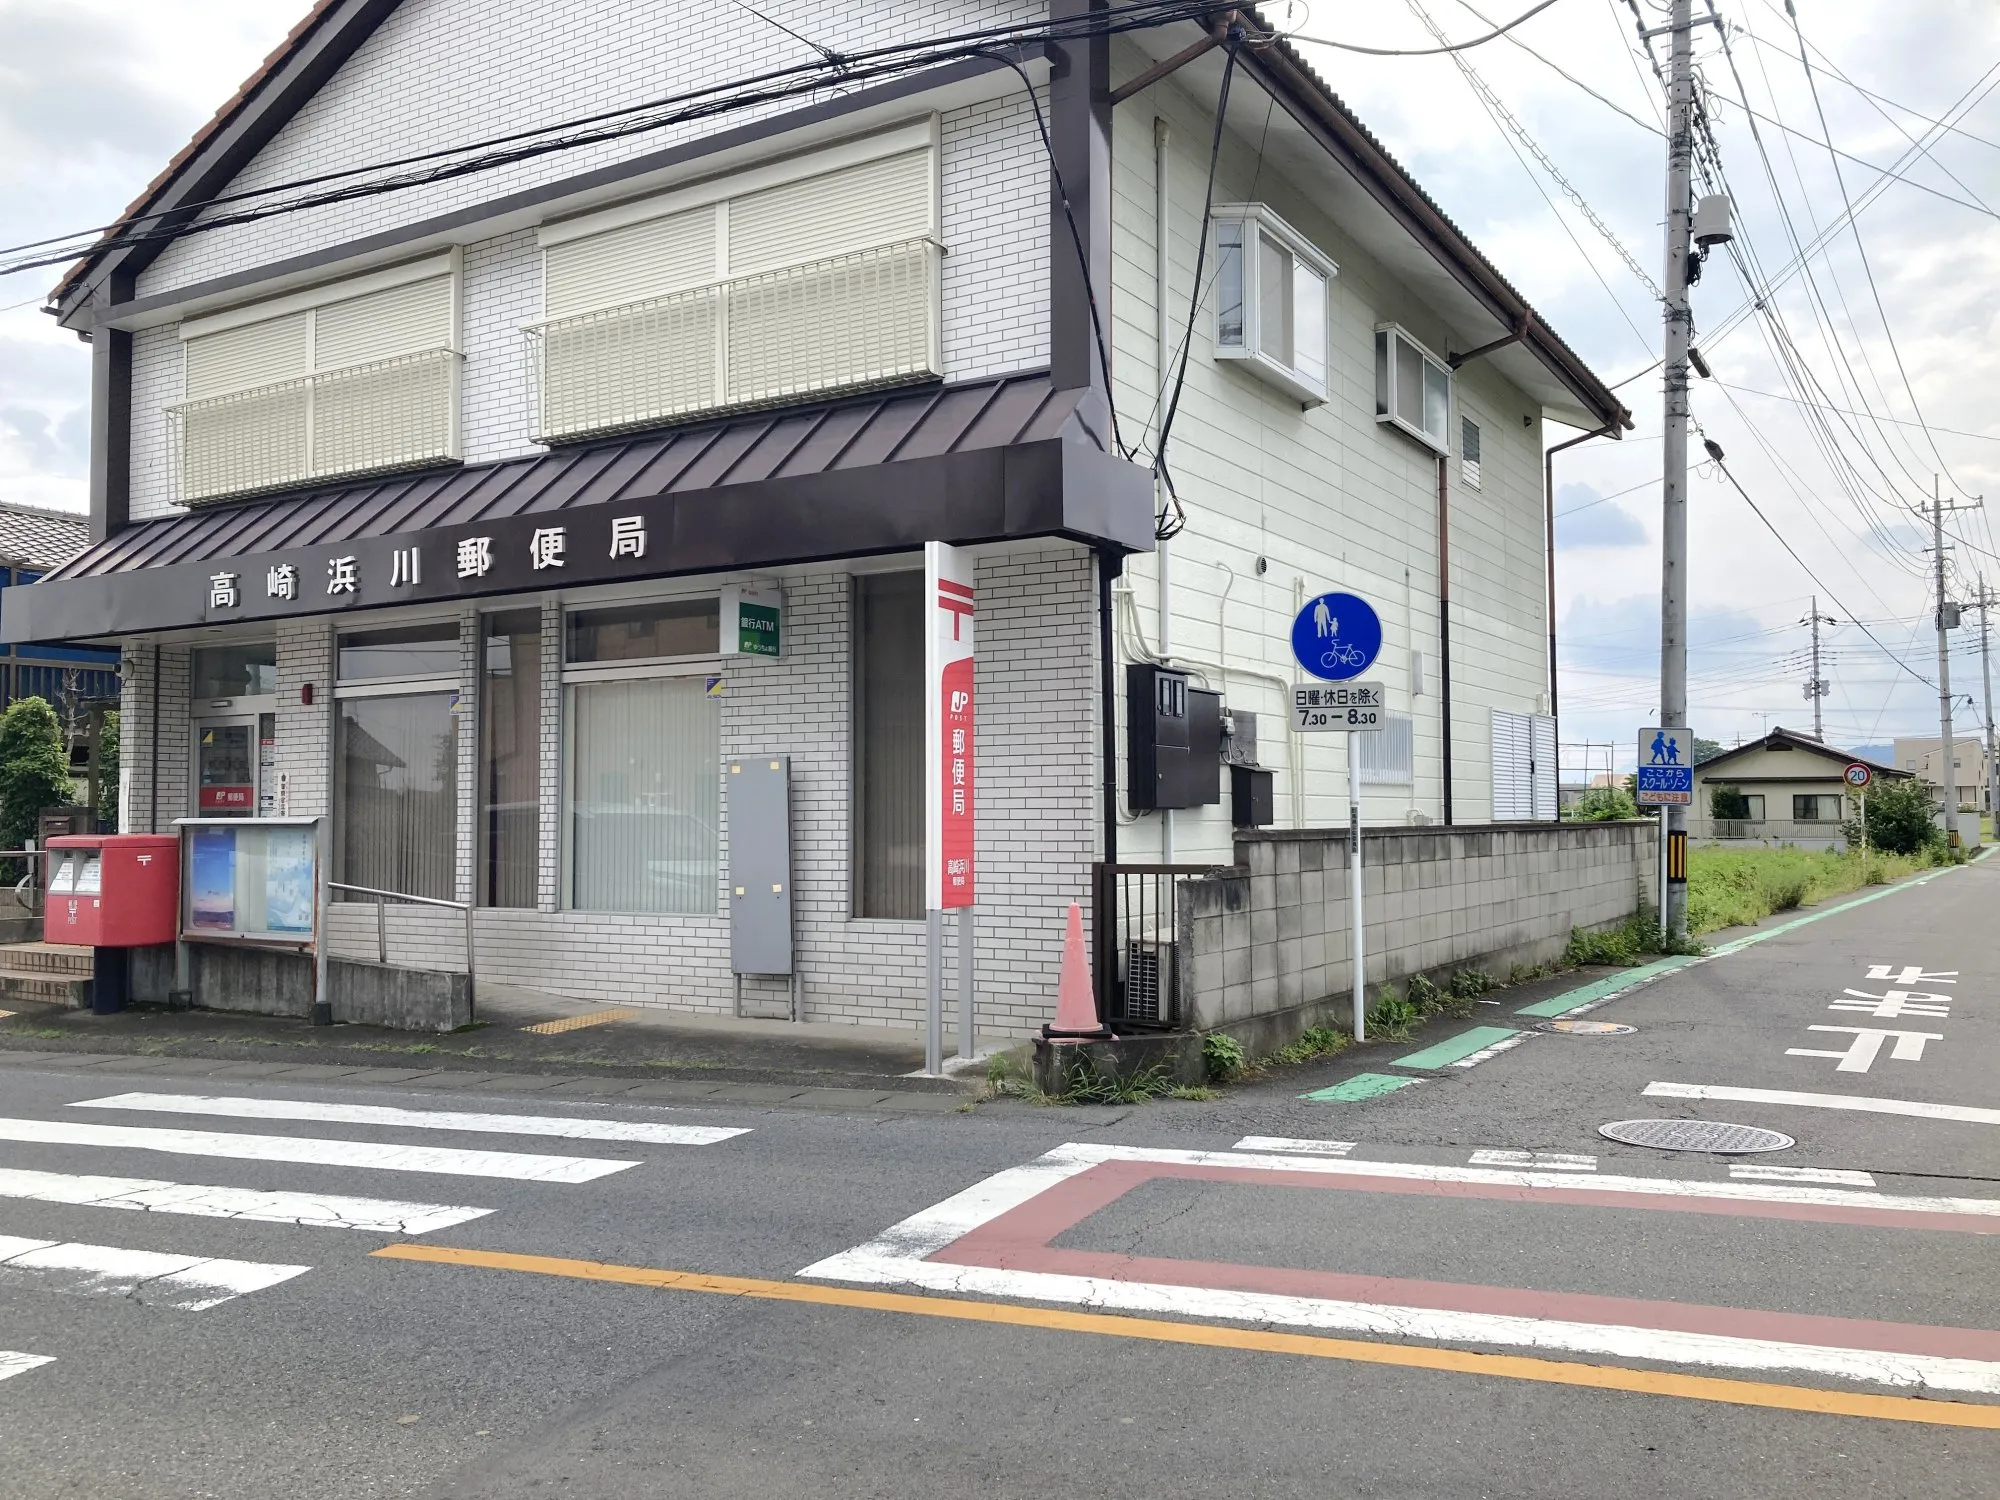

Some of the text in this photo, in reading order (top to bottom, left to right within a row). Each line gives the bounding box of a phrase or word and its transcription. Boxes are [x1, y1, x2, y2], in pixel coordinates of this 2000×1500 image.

[209, 515, 648, 607] 高崎浜川郵便局
[740, 617, 775, 632] 銀行ATM
[1296, 688, 1379, 706] 日曜・休日を除く
[952, 728, 966, 816] 郵便局
[1646, 769, 1685, 778] ここから
[1850, 770, 1865, 781] 20
[1641, 792, 1689, 803] こどもに注意
[947, 858, 970, 875] 高崎浜川
